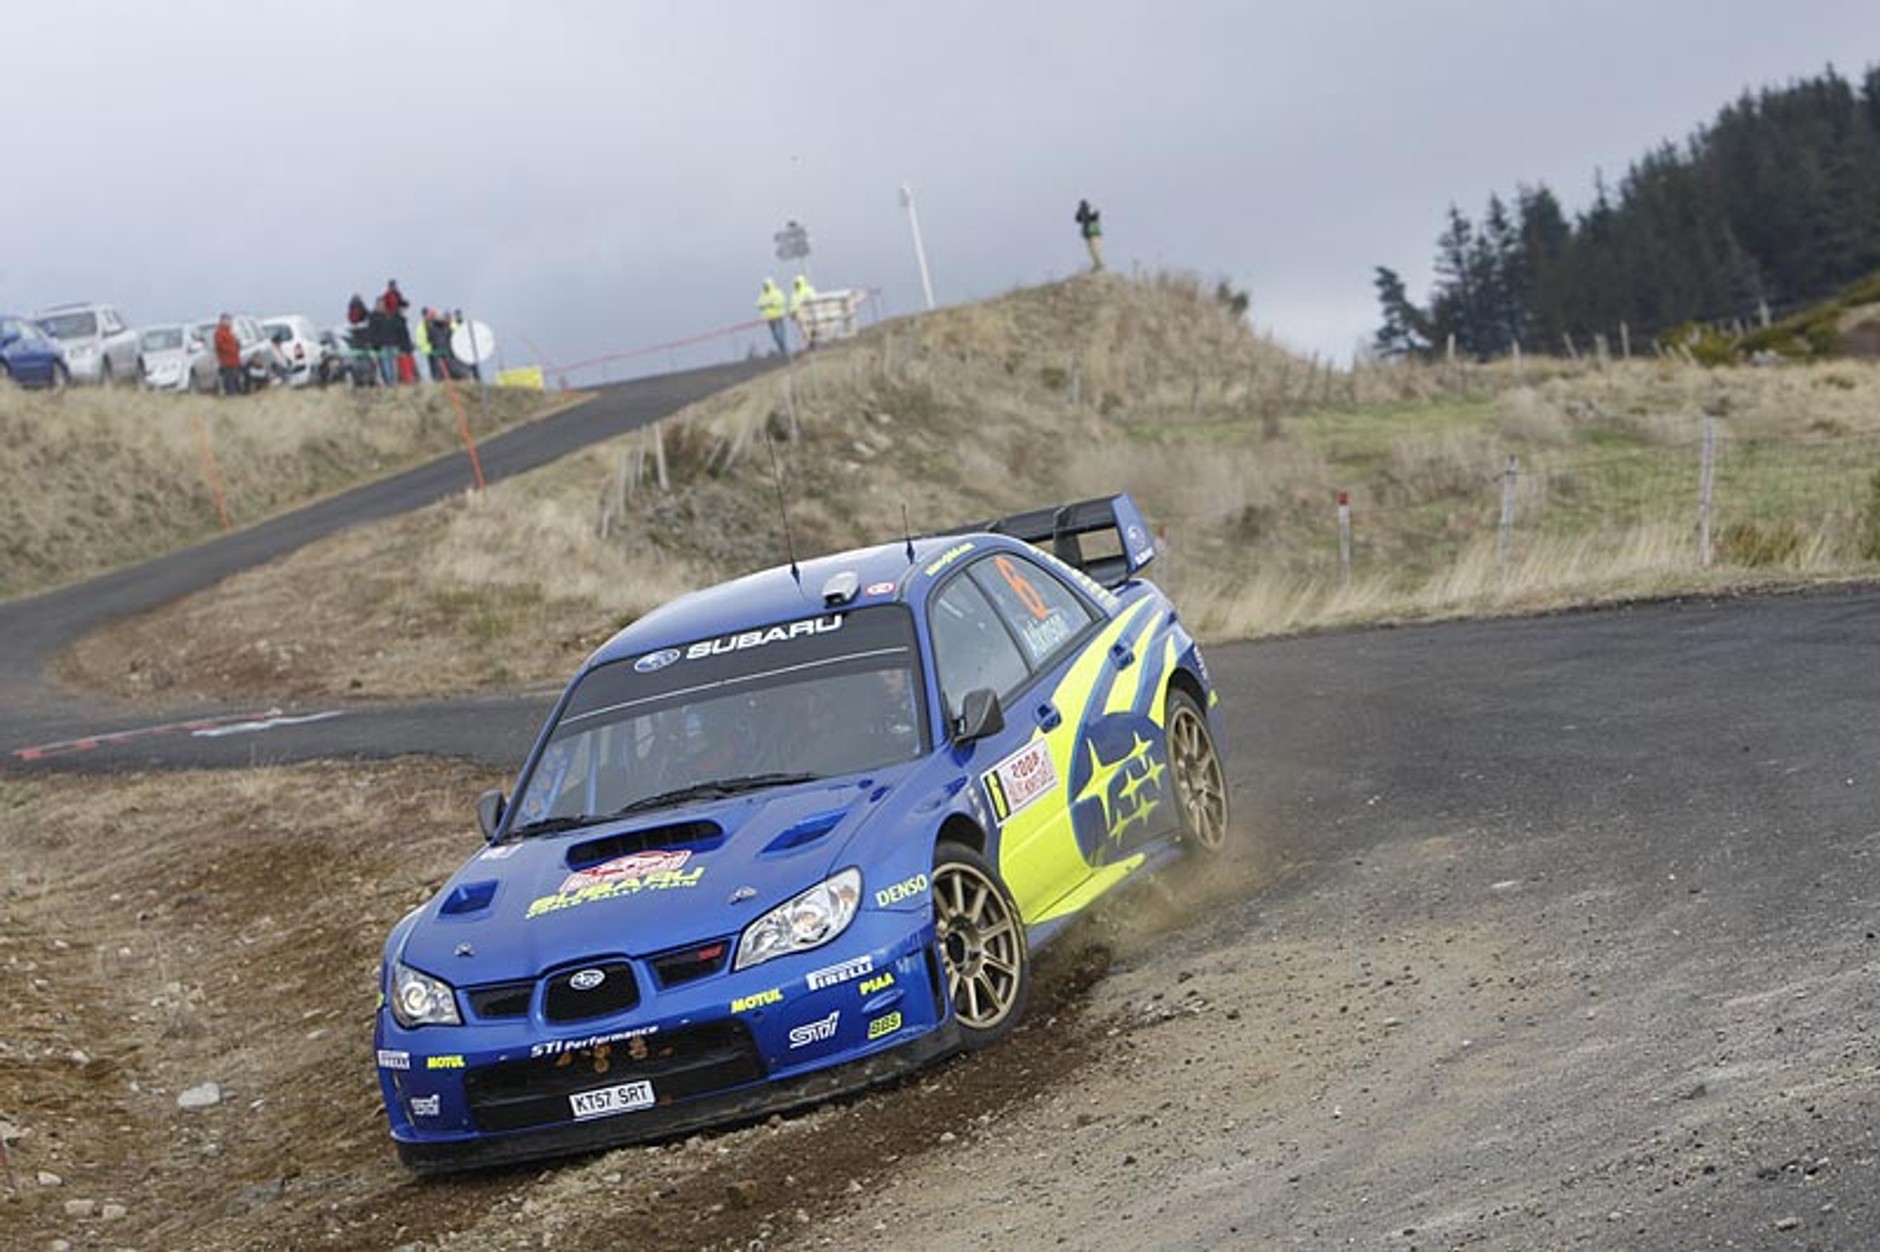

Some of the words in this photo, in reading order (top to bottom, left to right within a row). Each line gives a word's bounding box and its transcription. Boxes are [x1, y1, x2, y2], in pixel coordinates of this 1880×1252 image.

[686, 614, 842, 660] SUBARU
[528, 866, 704, 915] SUBARU
[875, 873, 928, 908] DENSO
[806, 955, 874, 991] PIRELLI
[859, 972, 895, 995] PIAA
[730, 988, 784, 1013] MOTUL
[531, 1039, 562, 1058] STI
[565, 1026, 660, 1050] Performance
[427, 1055, 465, 1069] MOTUL
[574, 1090, 613, 1113] KT57
[618, 1084, 649, 1106] SRT
